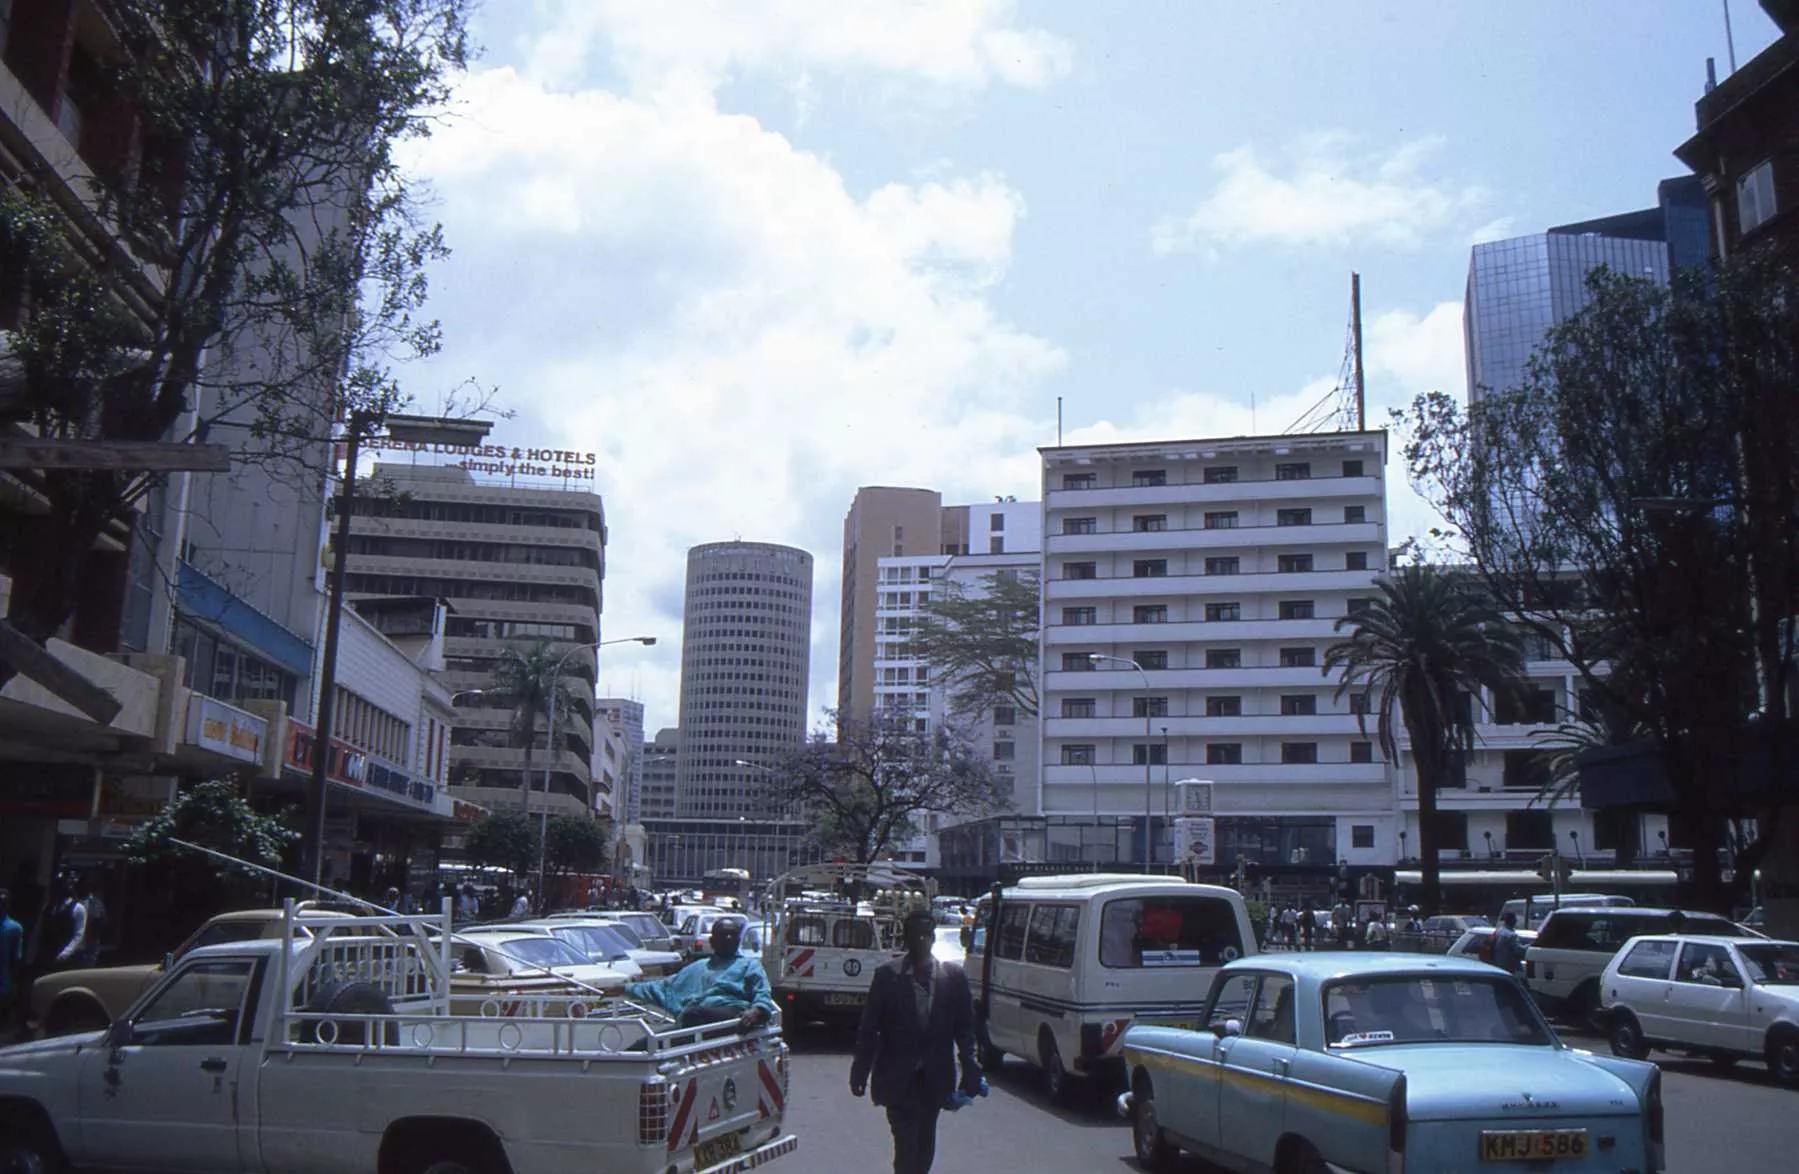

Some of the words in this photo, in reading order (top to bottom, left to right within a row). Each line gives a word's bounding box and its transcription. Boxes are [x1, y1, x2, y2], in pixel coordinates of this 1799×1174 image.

[435, 443, 506, 458] LODGES
[511, 447, 521, 460] &
[528, 448, 596, 465] HOTELS
[519, 461, 547, 477] the
[552, 464, 595, 480] best!
[1485, 1134, 1532, 1157] KMJ
[1543, 1133, 1585, 1155] 586
